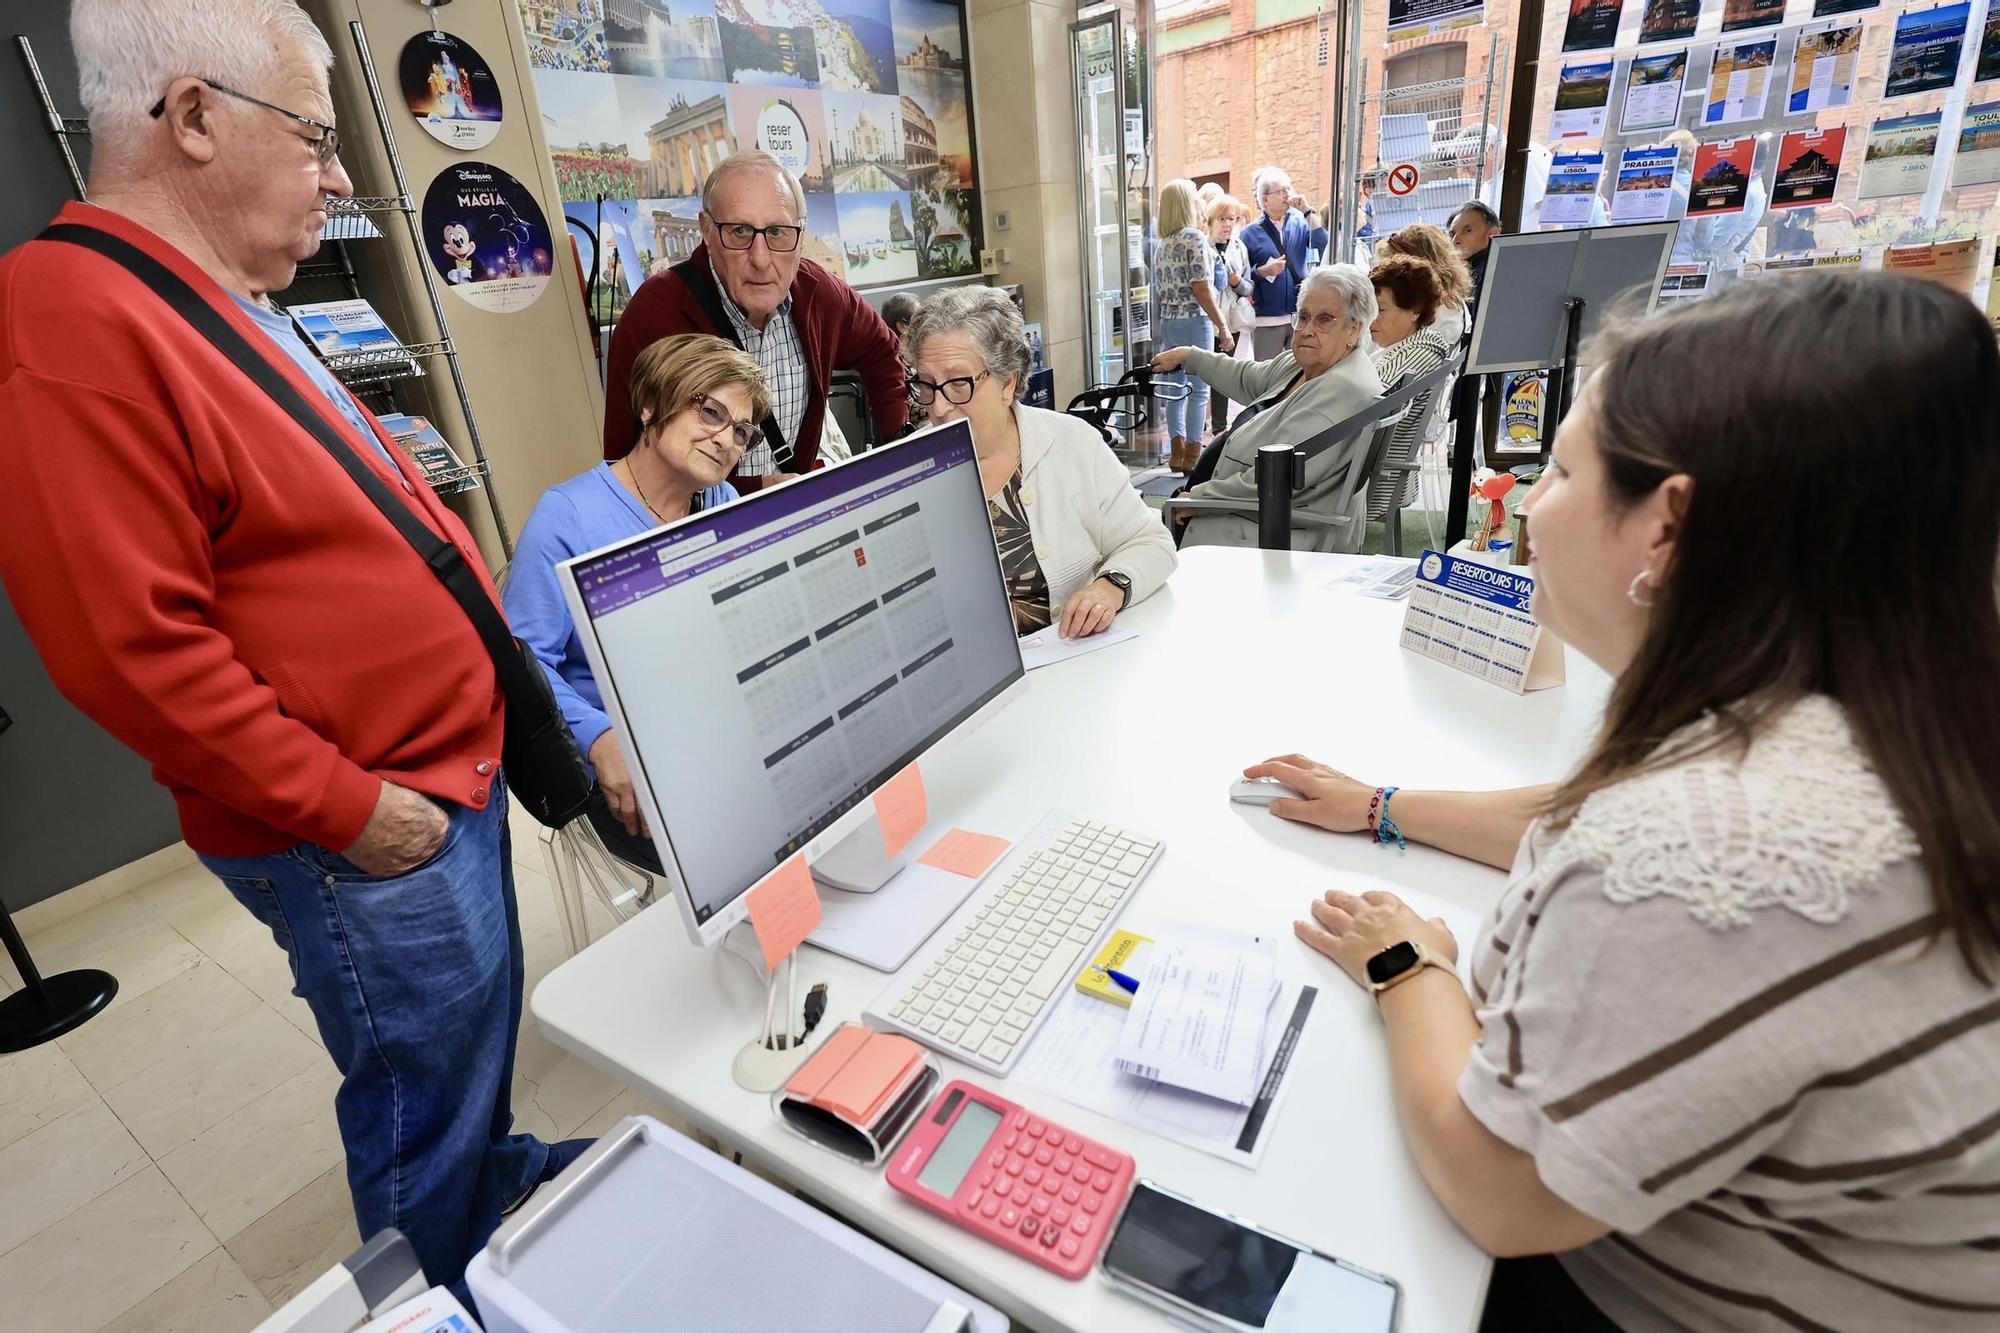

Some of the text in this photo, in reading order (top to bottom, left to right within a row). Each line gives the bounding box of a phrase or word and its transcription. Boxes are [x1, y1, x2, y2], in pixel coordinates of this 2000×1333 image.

[766, 125, 791, 136] reser
[768, 136, 793, 151] tours
[1624, 160, 1655, 169] PRAGA
[457, 193, 506, 207] MAGIA
[1817, 255, 1863, 265] IMSERSO
[1450, 560, 1513, 589] RESERTOURS
